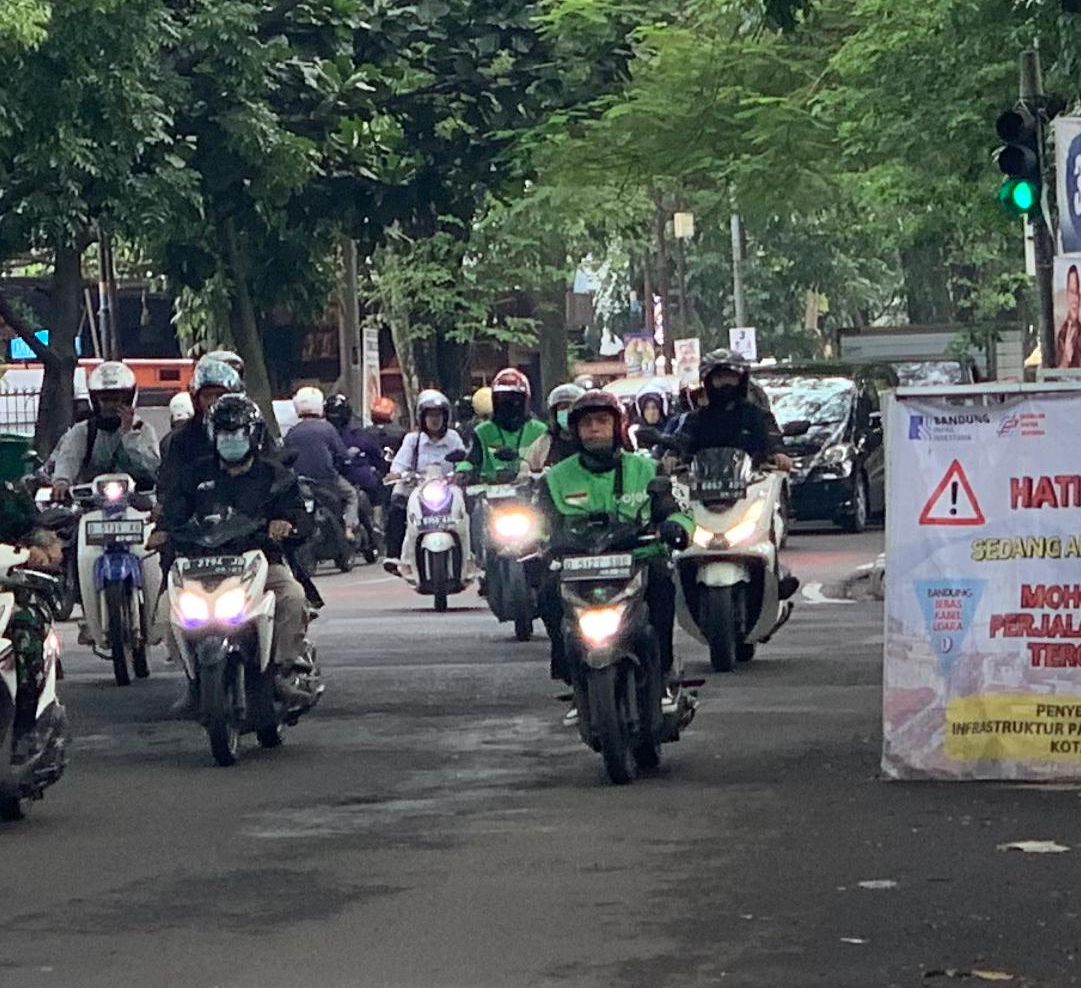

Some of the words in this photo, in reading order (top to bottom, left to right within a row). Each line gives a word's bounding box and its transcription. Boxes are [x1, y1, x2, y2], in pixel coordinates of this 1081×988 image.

[934, 413, 991, 426] BANDUNG
[1010, 474, 1081, 509] HATI
[970, 536, 1062, 562] SEDANG
[927, 588, 973, 598] BANDUNG
[951, 720, 1065, 735] INFRASTRUKTUR
